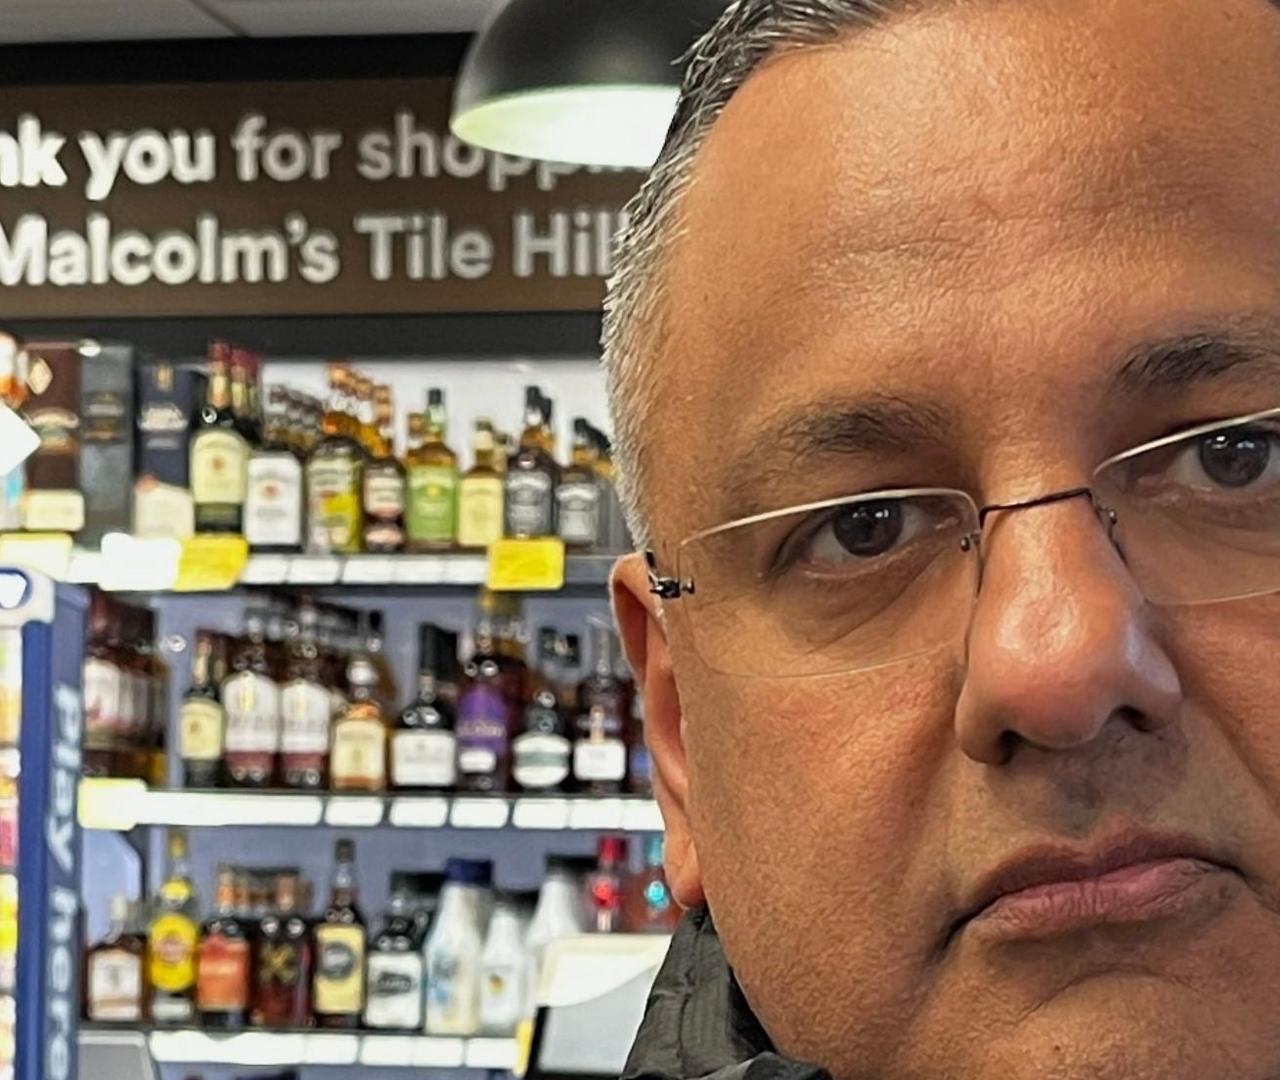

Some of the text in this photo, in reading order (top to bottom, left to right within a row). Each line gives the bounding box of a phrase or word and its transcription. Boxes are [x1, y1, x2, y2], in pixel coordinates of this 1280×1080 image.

[79, 129, 216, 199] you
[233, 113, 341, 184] for
[354, 211, 494, 279] Tile
[46, 683, 81, 874] Play
